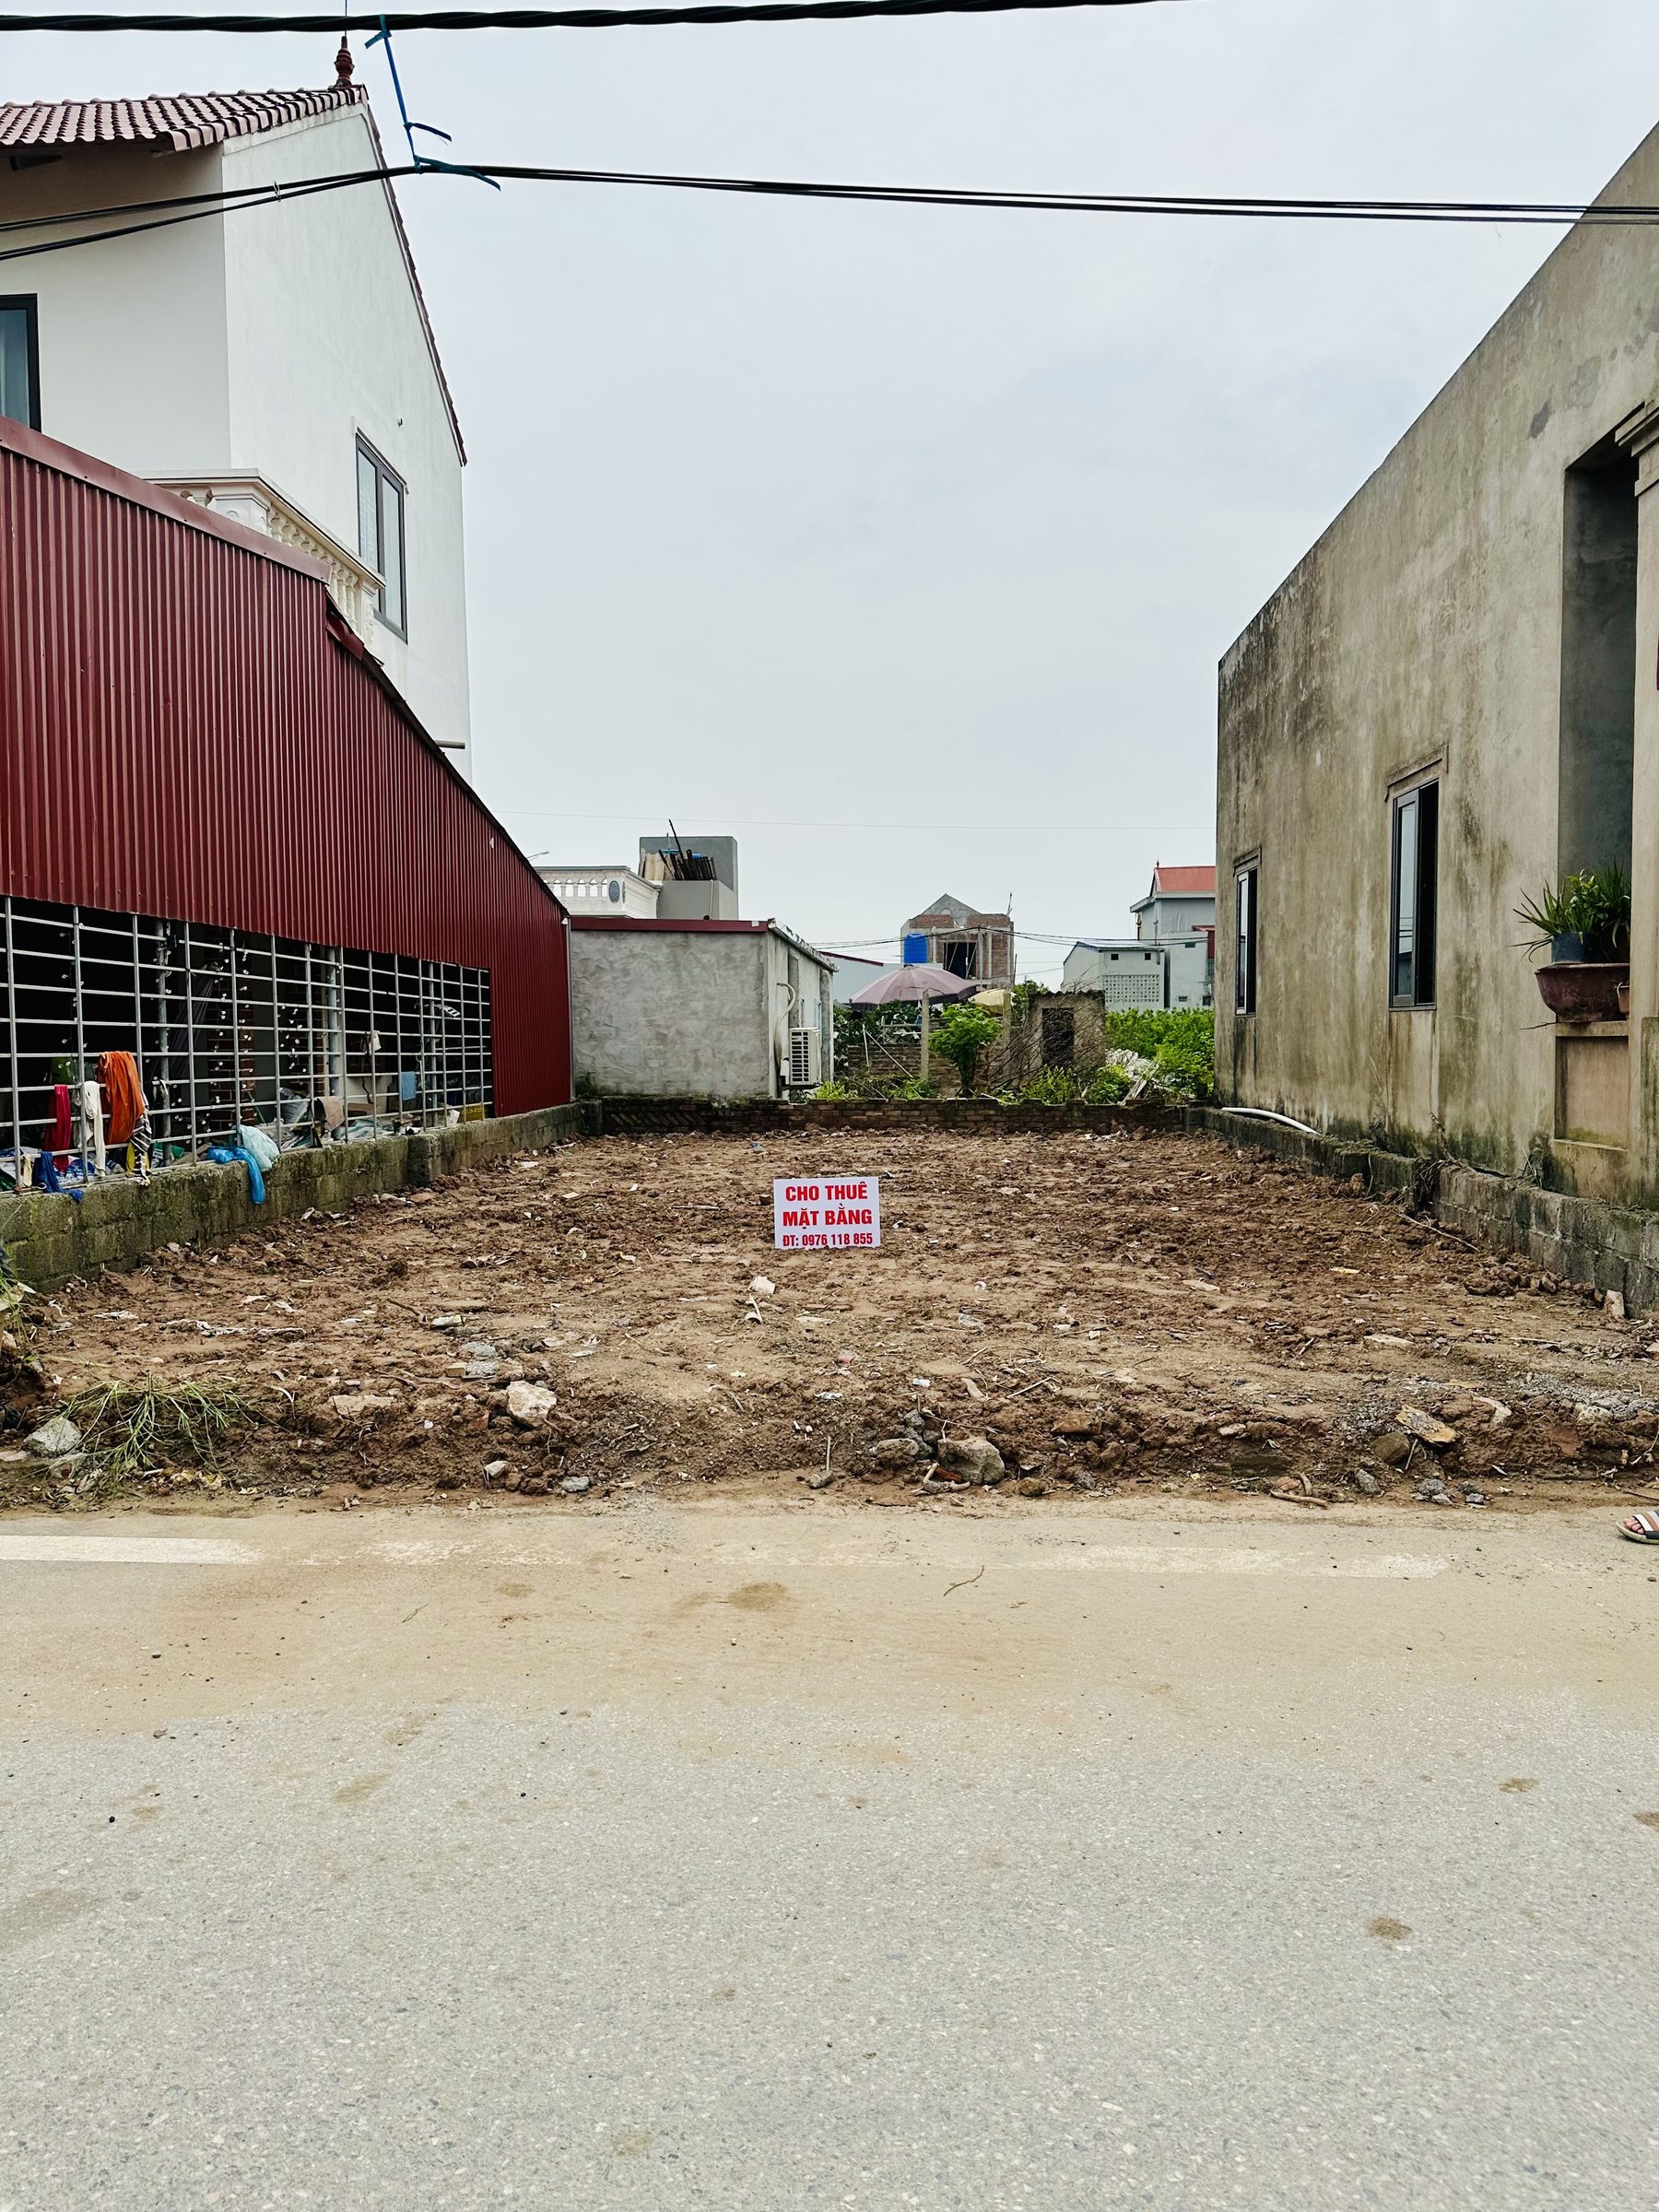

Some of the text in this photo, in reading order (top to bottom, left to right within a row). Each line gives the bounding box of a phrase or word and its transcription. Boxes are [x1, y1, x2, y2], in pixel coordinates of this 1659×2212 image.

[785, 1181, 867, 1201] CHO THUÊ
[782, 1203, 873, 1230] MẶT BẰNG
[782, 1232, 873, 1246] ĐT: 0976 118 855
